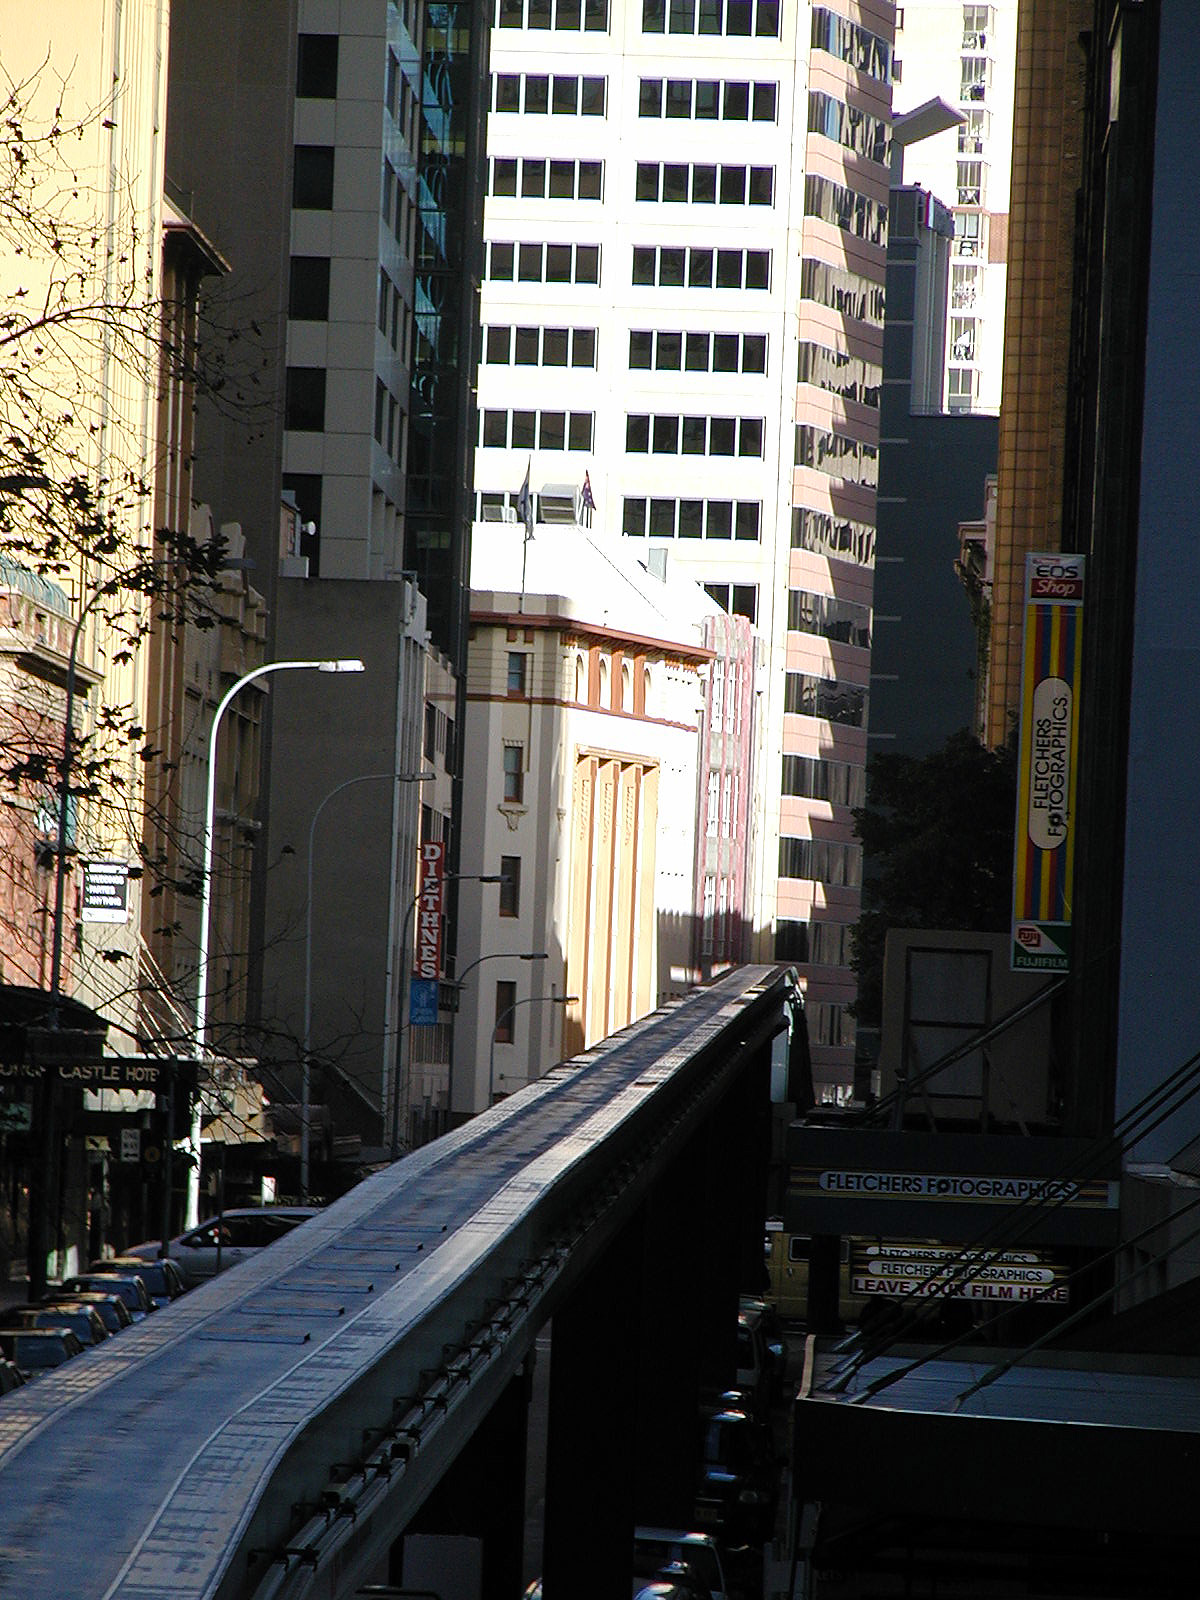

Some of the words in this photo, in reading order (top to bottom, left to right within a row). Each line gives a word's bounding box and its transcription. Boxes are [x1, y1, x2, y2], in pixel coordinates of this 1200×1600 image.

[1036, 565, 1078, 579] EOS
[1036, 580, 1076, 597] Shop
[1033, 718, 1051, 809] FLETCHERS
[1047, 697, 1068, 837] FOTOGRAPHICS
[420, 843, 442, 979] DIETHNES
[1016, 956, 1068, 968] FUJIFILM
[58, 1065, 121, 1081] CASTLE
[826, 1173, 922, 1193] FLETCHERS
[854, 1279, 910, 1294] LEAVE
[972, 1285, 1013, 1299] FILM
